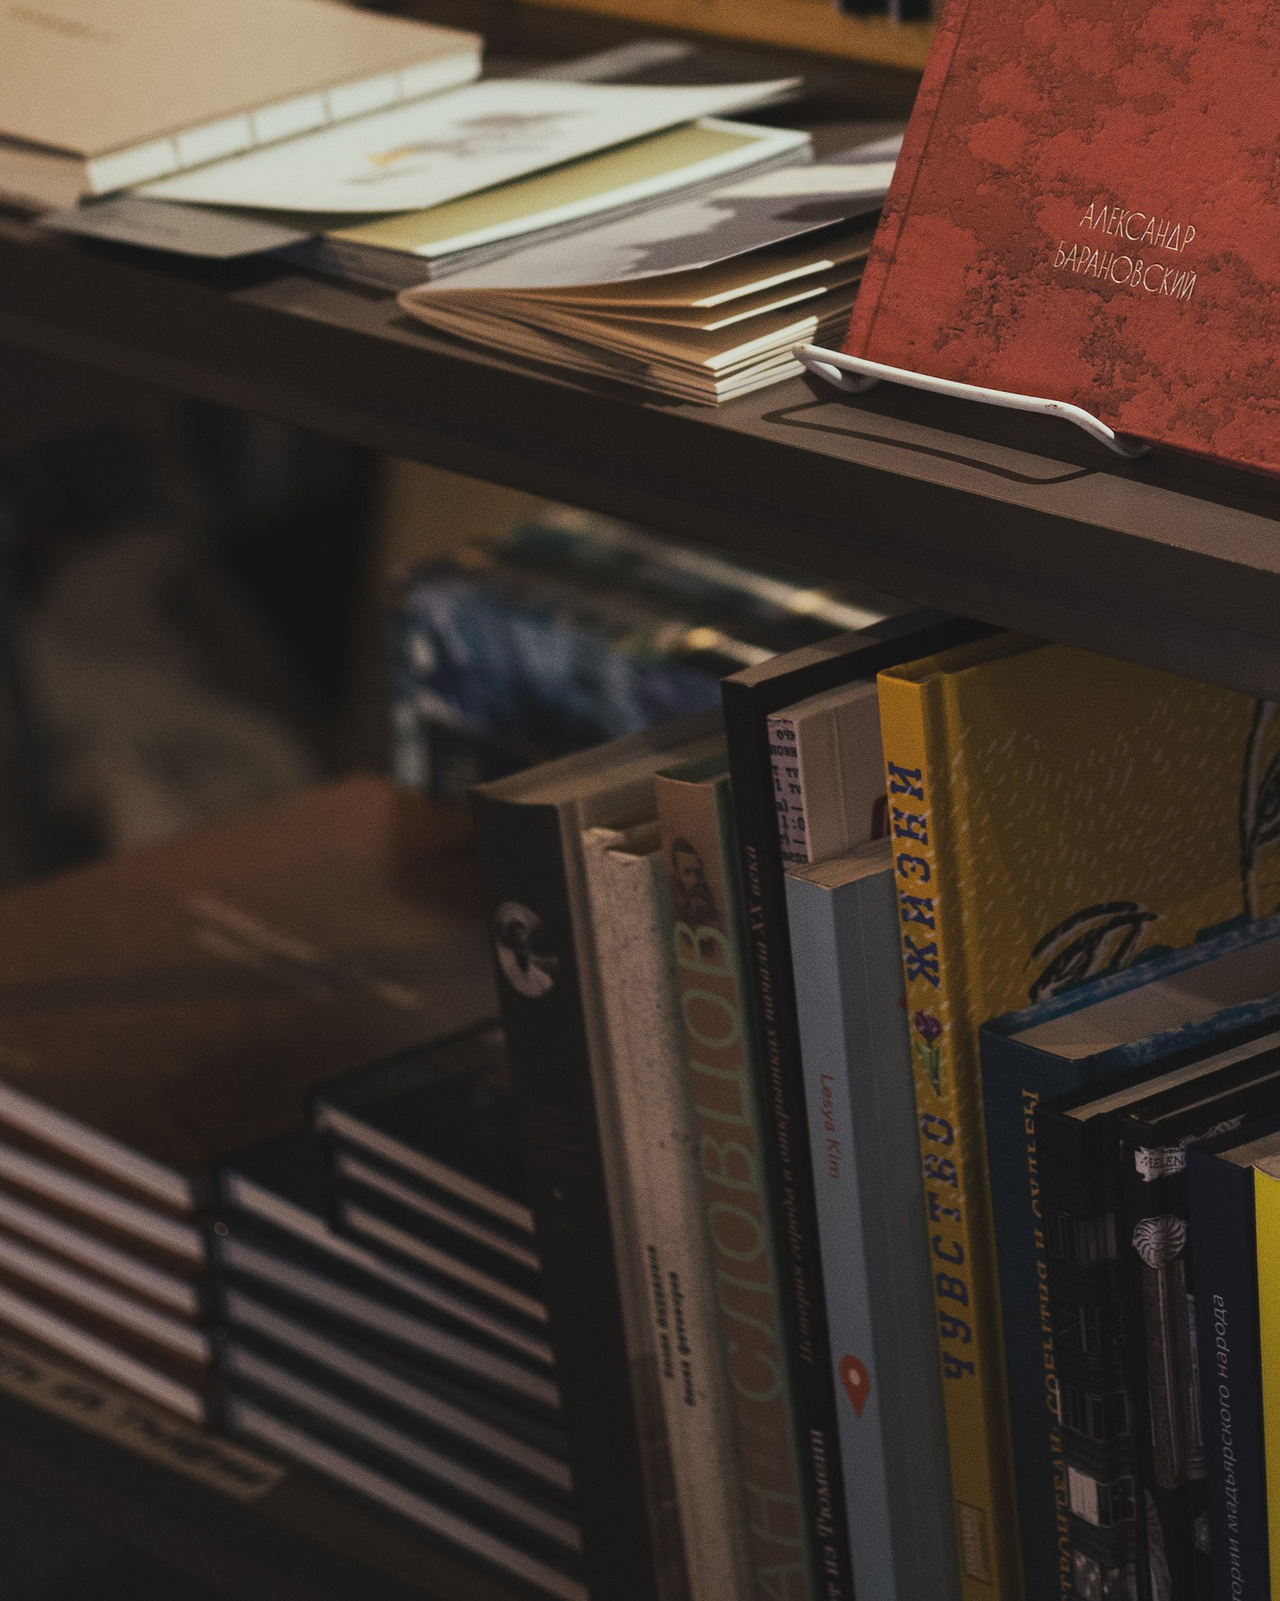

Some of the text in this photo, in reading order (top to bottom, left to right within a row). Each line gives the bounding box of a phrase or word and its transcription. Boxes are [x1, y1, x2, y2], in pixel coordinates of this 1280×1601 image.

[1079, 201, 1196, 253] АЛЕКСАНДР
[1053, 239, 1197, 302] БАРАНОВСКИЙ
[744, 844, 762, 899] века
[757, 941, 777, 1022] начала
[767, 1024, 791, 1164] открытках
[888, 760, 976, 1381] ЧУВСТВО ЖИЗНИ
[673, 921, 787, 1402] СЛОВЦОВ
[825, 1138, 841, 1180] Kim
[782, 1186, 804, 1259] города
[792, 1263, 815, 1364] История
[1212, 1294, 1231, 1379] народа
[809, 1428, 835, 1538] Тюмени
[1218, 1383, 1239, 1534] мадьярского
